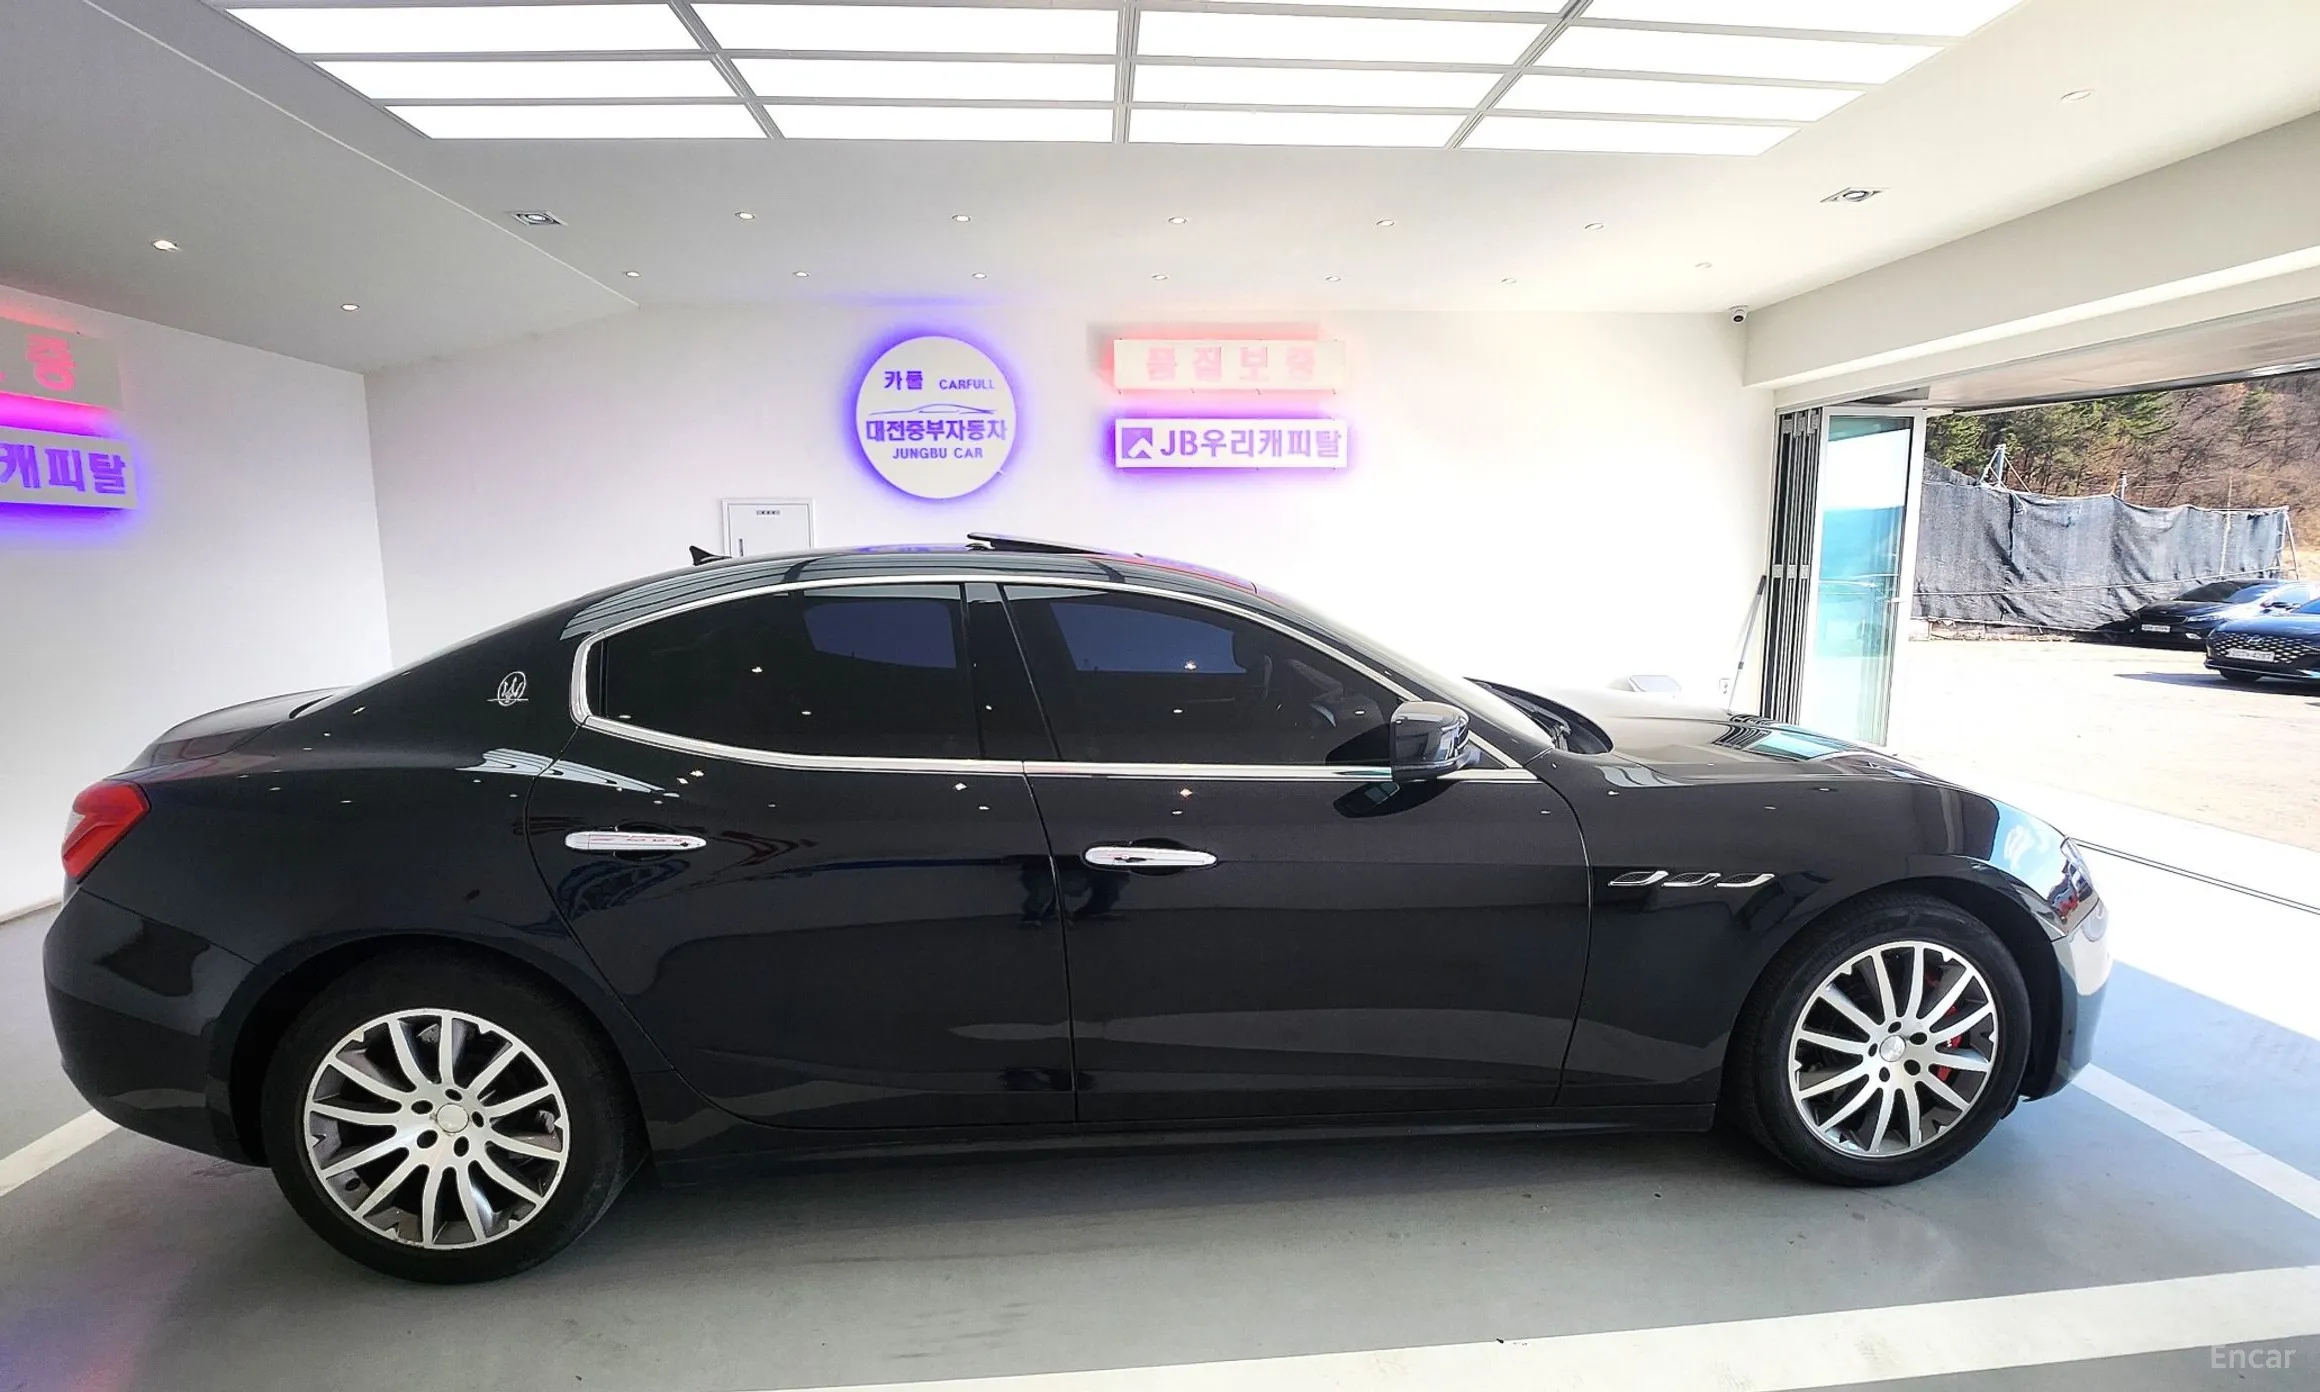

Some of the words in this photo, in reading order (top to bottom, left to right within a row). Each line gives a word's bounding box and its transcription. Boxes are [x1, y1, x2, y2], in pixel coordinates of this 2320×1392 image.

[0, 333, 76, 392] 증
[939, 379, 995, 390] CARFULL
[892, 448, 947, 459] JUNGBU
[954, 448, 983, 458] CAR
[1160, 429, 1341, 458] JB우리캐피탈
